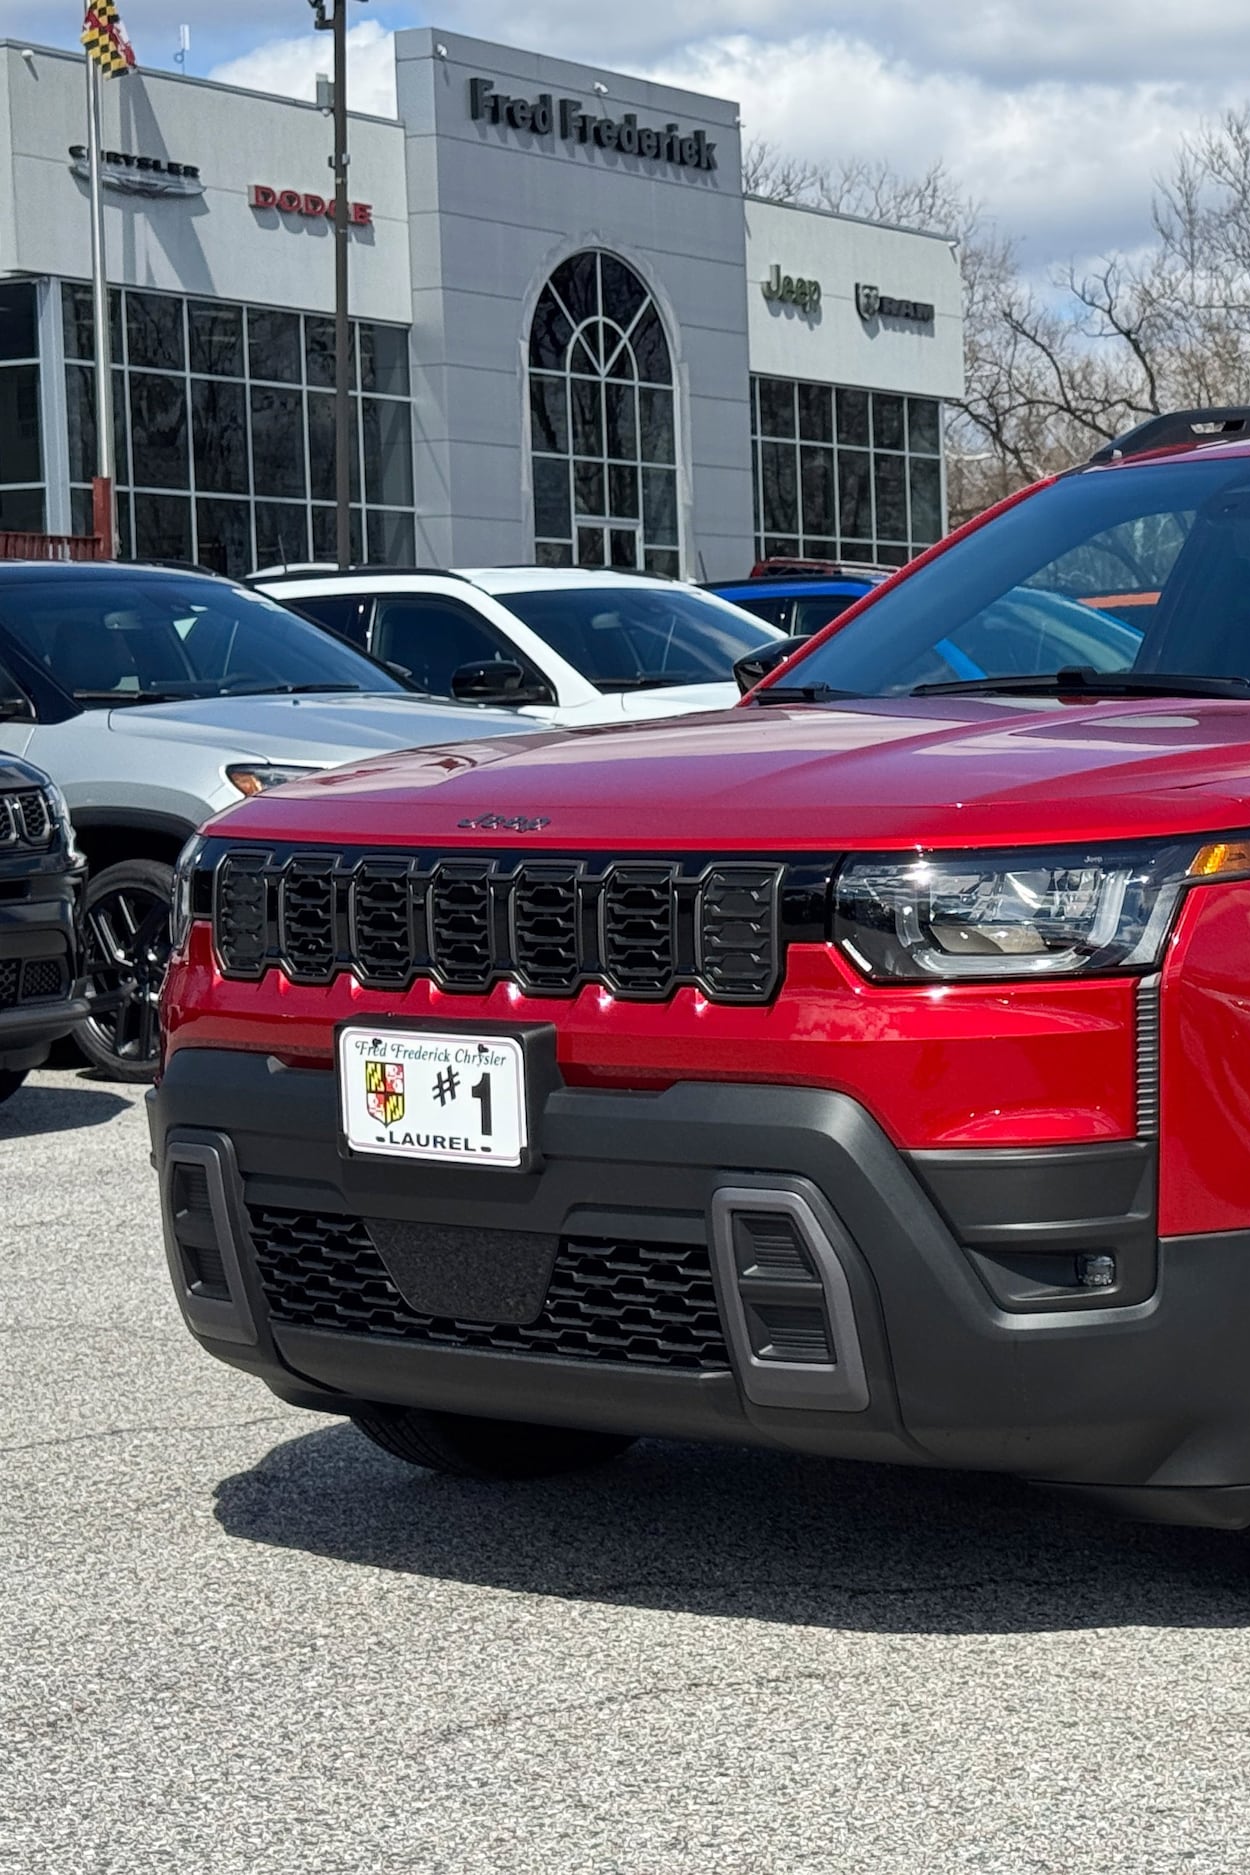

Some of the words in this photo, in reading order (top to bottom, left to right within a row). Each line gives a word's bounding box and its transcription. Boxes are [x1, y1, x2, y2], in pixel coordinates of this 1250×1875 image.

[469, 77, 552, 134] Fred
[559, 98, 718, 170] Frederick
[761, 264, 821, 314] Jeep
[880, 296, 935, 322] RAM
[457, 812, 551, 833] Jeep
[354, 1040, 387, 1057] Fred
[390, 1043, 450, 1063] Frederick
[455, 1048, 507, 1068] Chrysler
[389, 1131, 476, 1152] LAUREL
